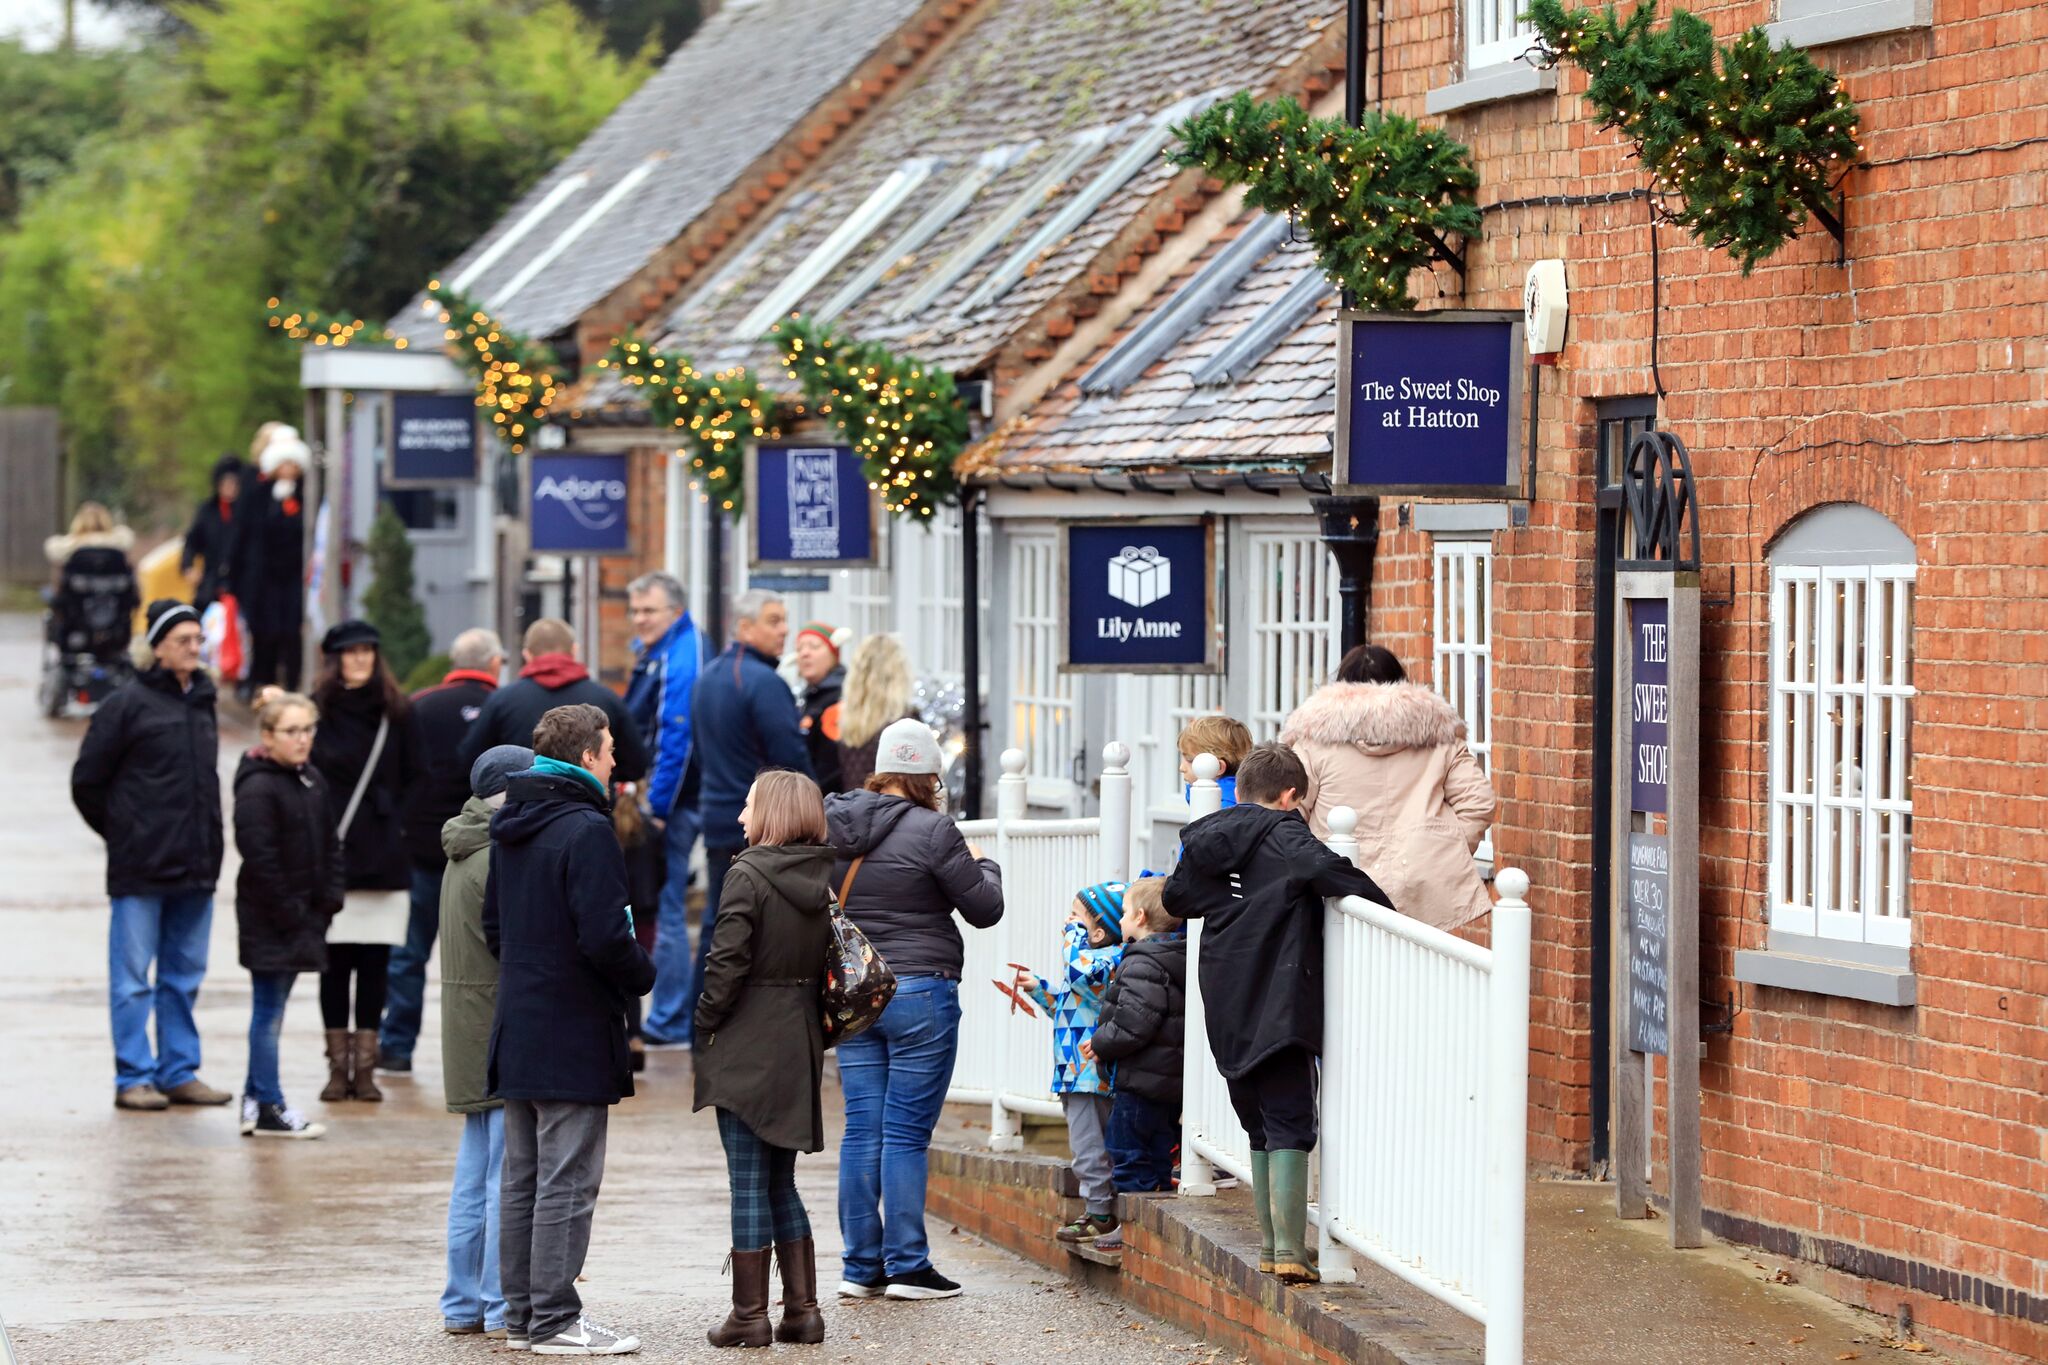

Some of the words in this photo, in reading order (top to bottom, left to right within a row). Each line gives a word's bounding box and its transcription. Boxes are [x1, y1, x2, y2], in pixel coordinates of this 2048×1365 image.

[1361, 380, 1395, 401] The
[1400, 376, 1451, 400] Sweet
[1456, 378, 1500, 407] Shop
[1382, 408, 1401, 428] at
[1407, 405, 1479, 428] Hatton
[1097, 616, 1133, 643] Lily
[1133, 617, 1182, 638] Anne
[1642, 623, 1667, 662] THE
[1634, 682, 1668, 724] SWEE
[1651, 882, 1663, 911] 30
[1653, 994, 1666, 1022] PIE
